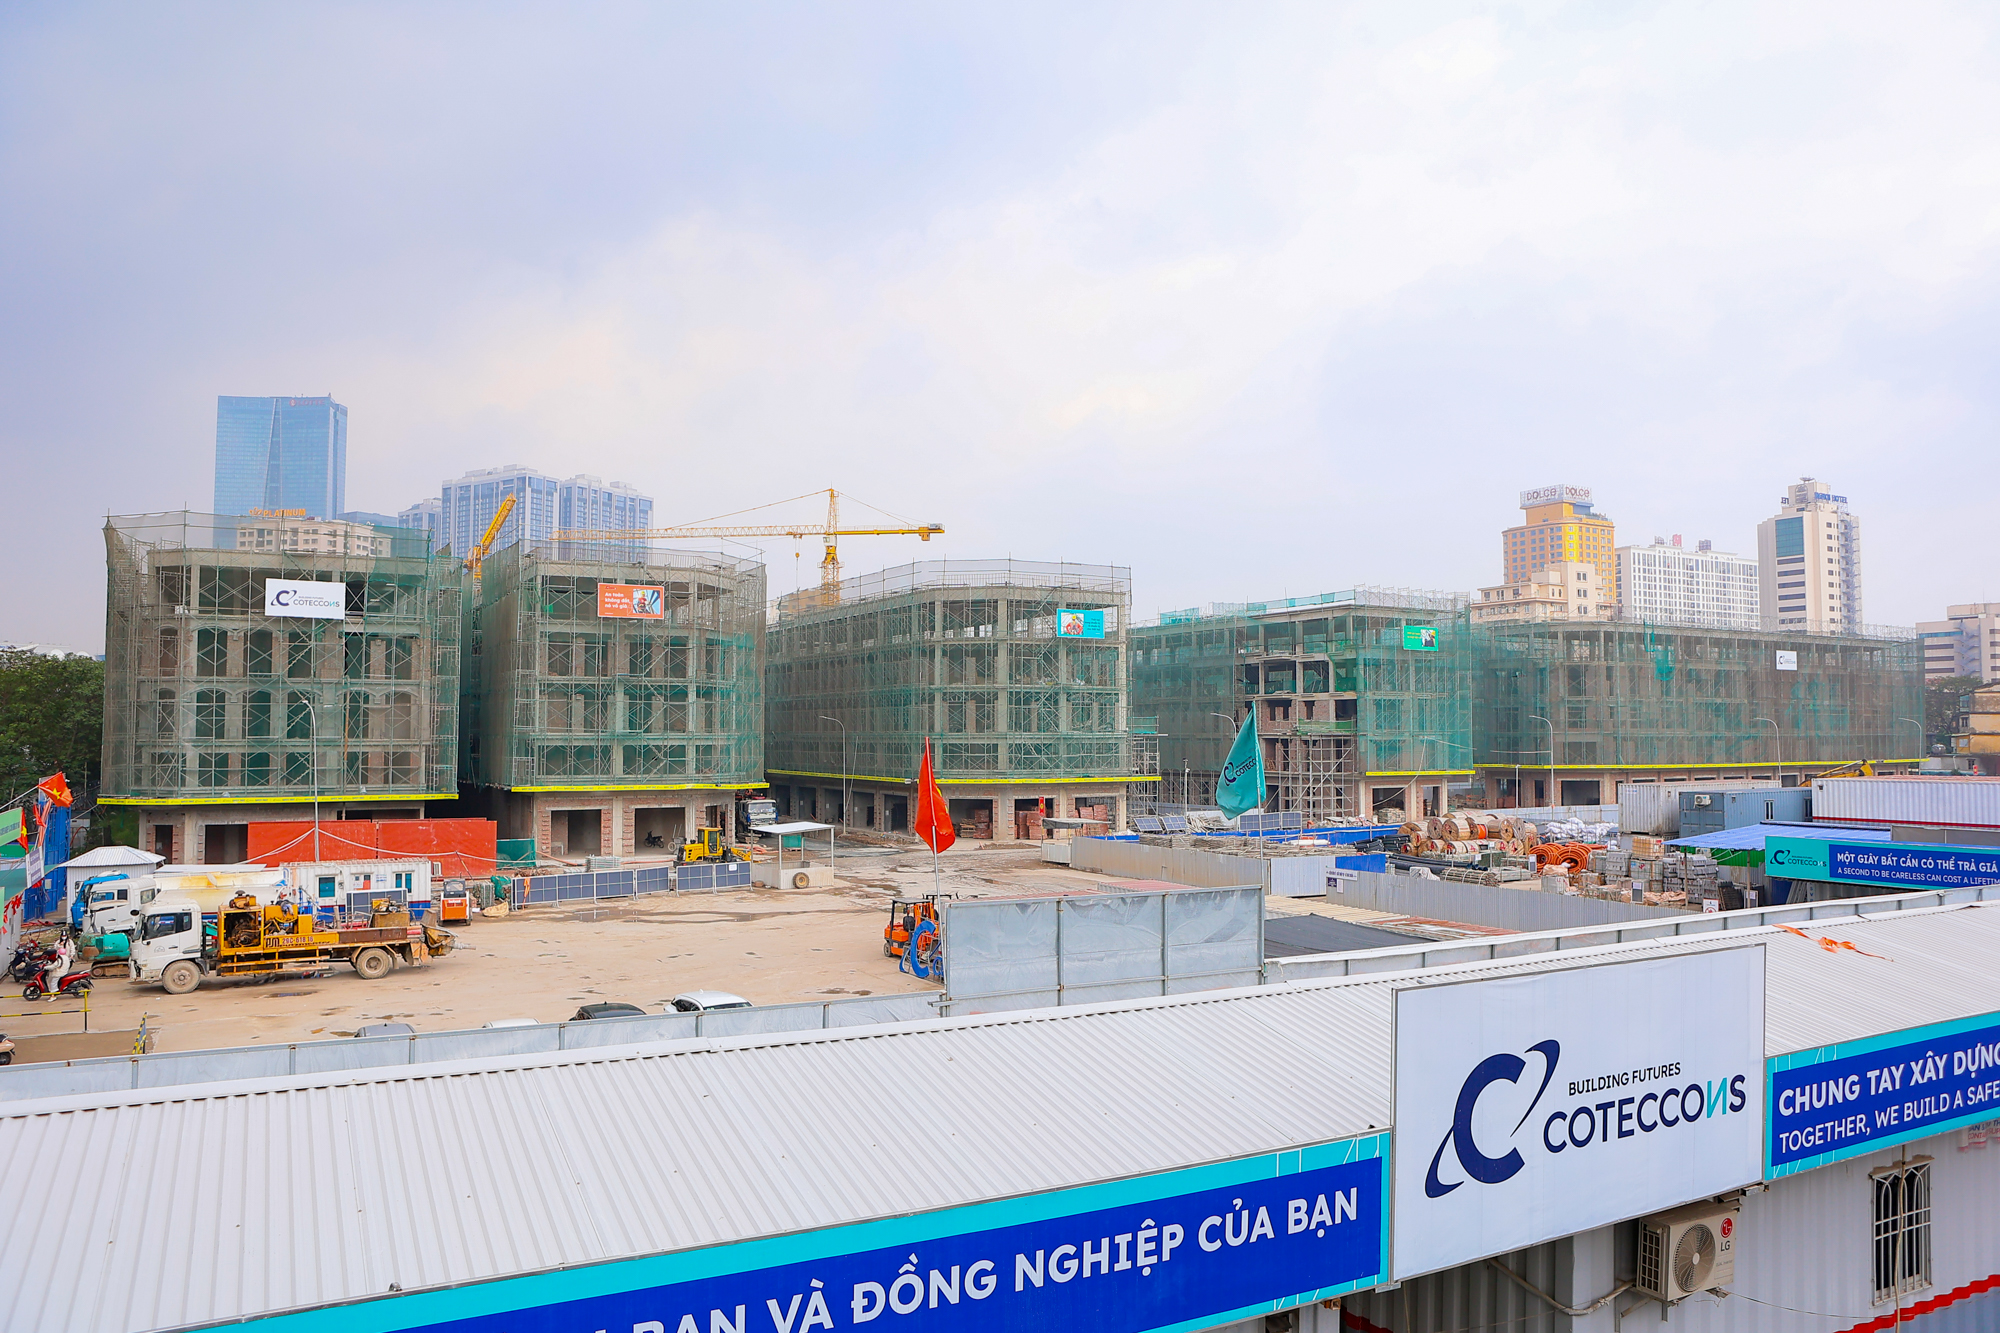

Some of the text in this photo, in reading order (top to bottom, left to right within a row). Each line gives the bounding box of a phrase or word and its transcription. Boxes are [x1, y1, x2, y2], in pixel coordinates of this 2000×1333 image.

[263, 508, 306, 518] PLATINUM
[1837, 851, 1999, 873] MỘT GIÂY BẤT CẨN CÓ THỂ TRẢ GIÁ
[1843, 867, 1870, 876] SECOND
[1871, 869, 1880, 877] TO
[1881, 870, 1890, 878] BE
[1891, 871, 1925, 881] CARELESS
[1926, 873, 1942, 882] CAN
[1943, 875, 1961, 883] COST
[1963, 876, 1969, 884] A
[1568, 1062, 1681, 1096] BUILDING FUTURES
[1778, 1074, 1860, 1117] CHUNG
[1866, 1063, 1905, 1096] TAY
[1909, 1050, 1948, 1087] XÂY
[1543, 1074, 1747, 1154] COTECCONS
[1779, 1080, 2000, 1154] TOGETHER, WE BUILD A SAFE
[766, 1278, 835, 1333] VÀ
[850, 1253, 997, 1325] ĐỒNG
[1014, 1219, 1183, 1277] NGHIỆP
[1195, 1199, 1275, 1252] CỦA
[1288, 1187, 1359, 1239] BẠN
[1720, 1241, 1730, 1252] LG
